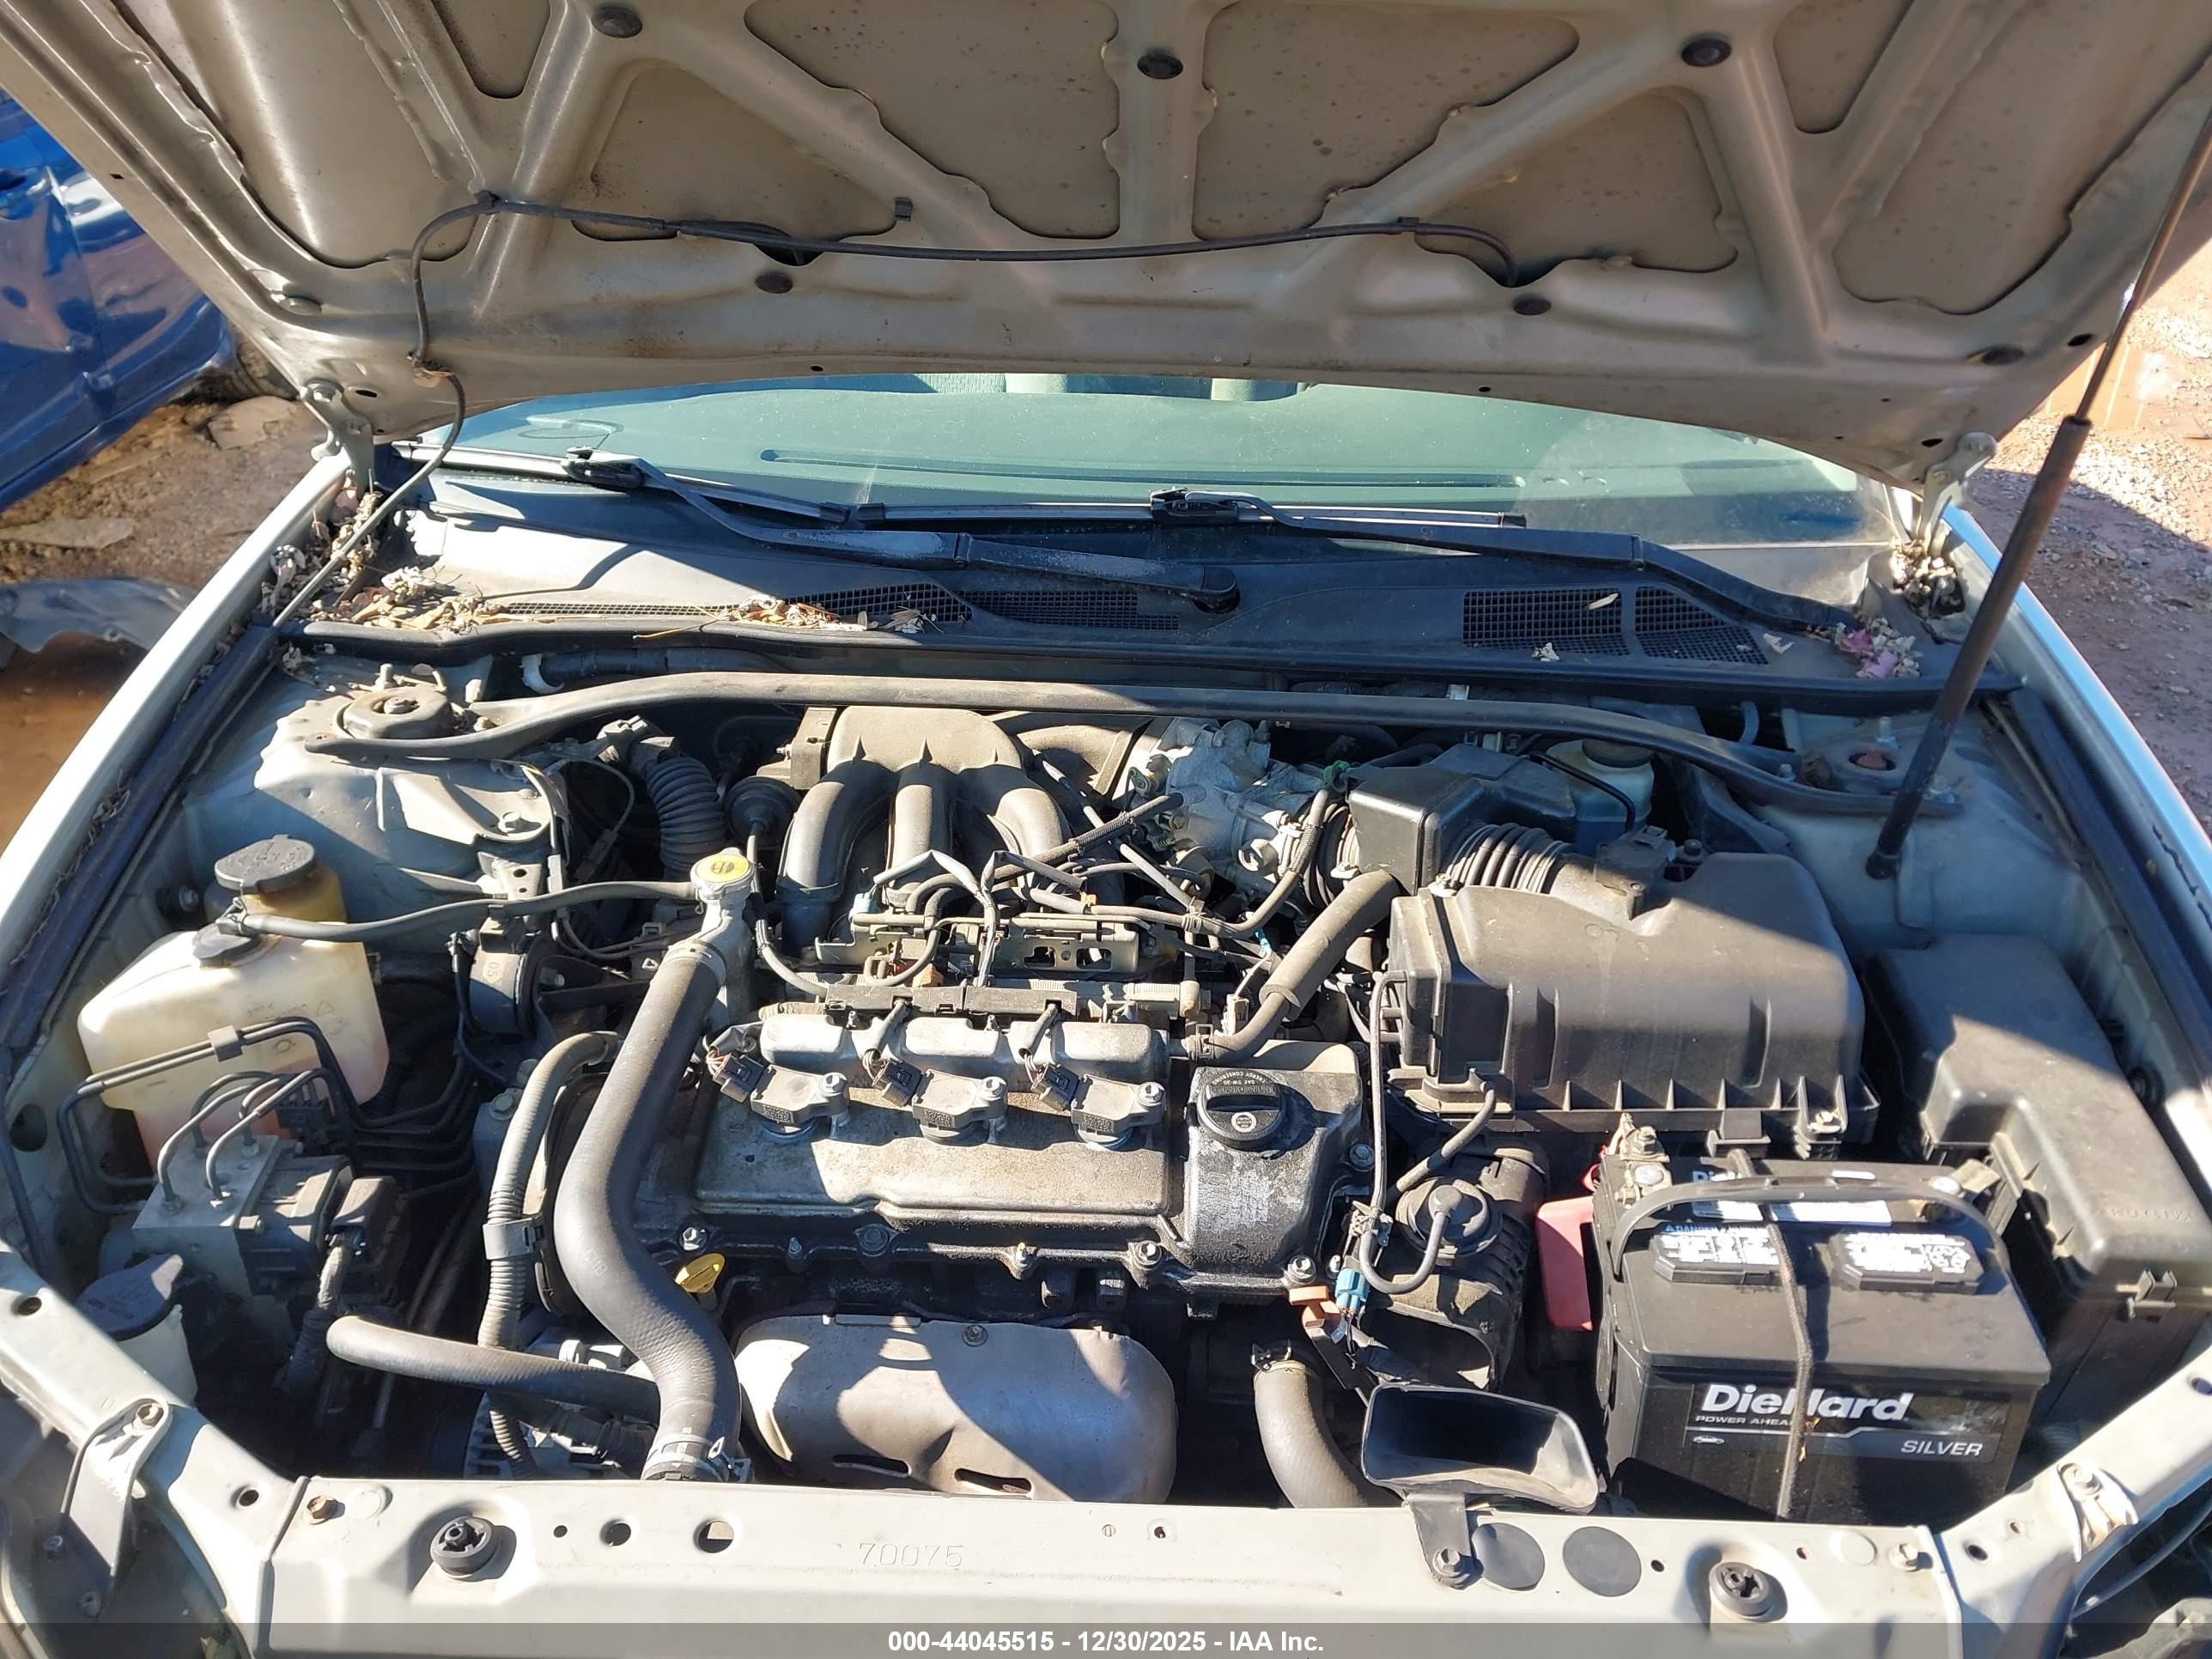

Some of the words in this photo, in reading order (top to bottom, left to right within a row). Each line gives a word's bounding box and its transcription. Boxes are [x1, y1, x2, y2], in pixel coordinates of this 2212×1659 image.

[1695, 1415, 1747, 1425] POWER
[1750, 1418, 1793, 1426] AHEA
[1900, 1439, 1984, 1456] SILVER
[860, 1542, 964, 1567] 70075
